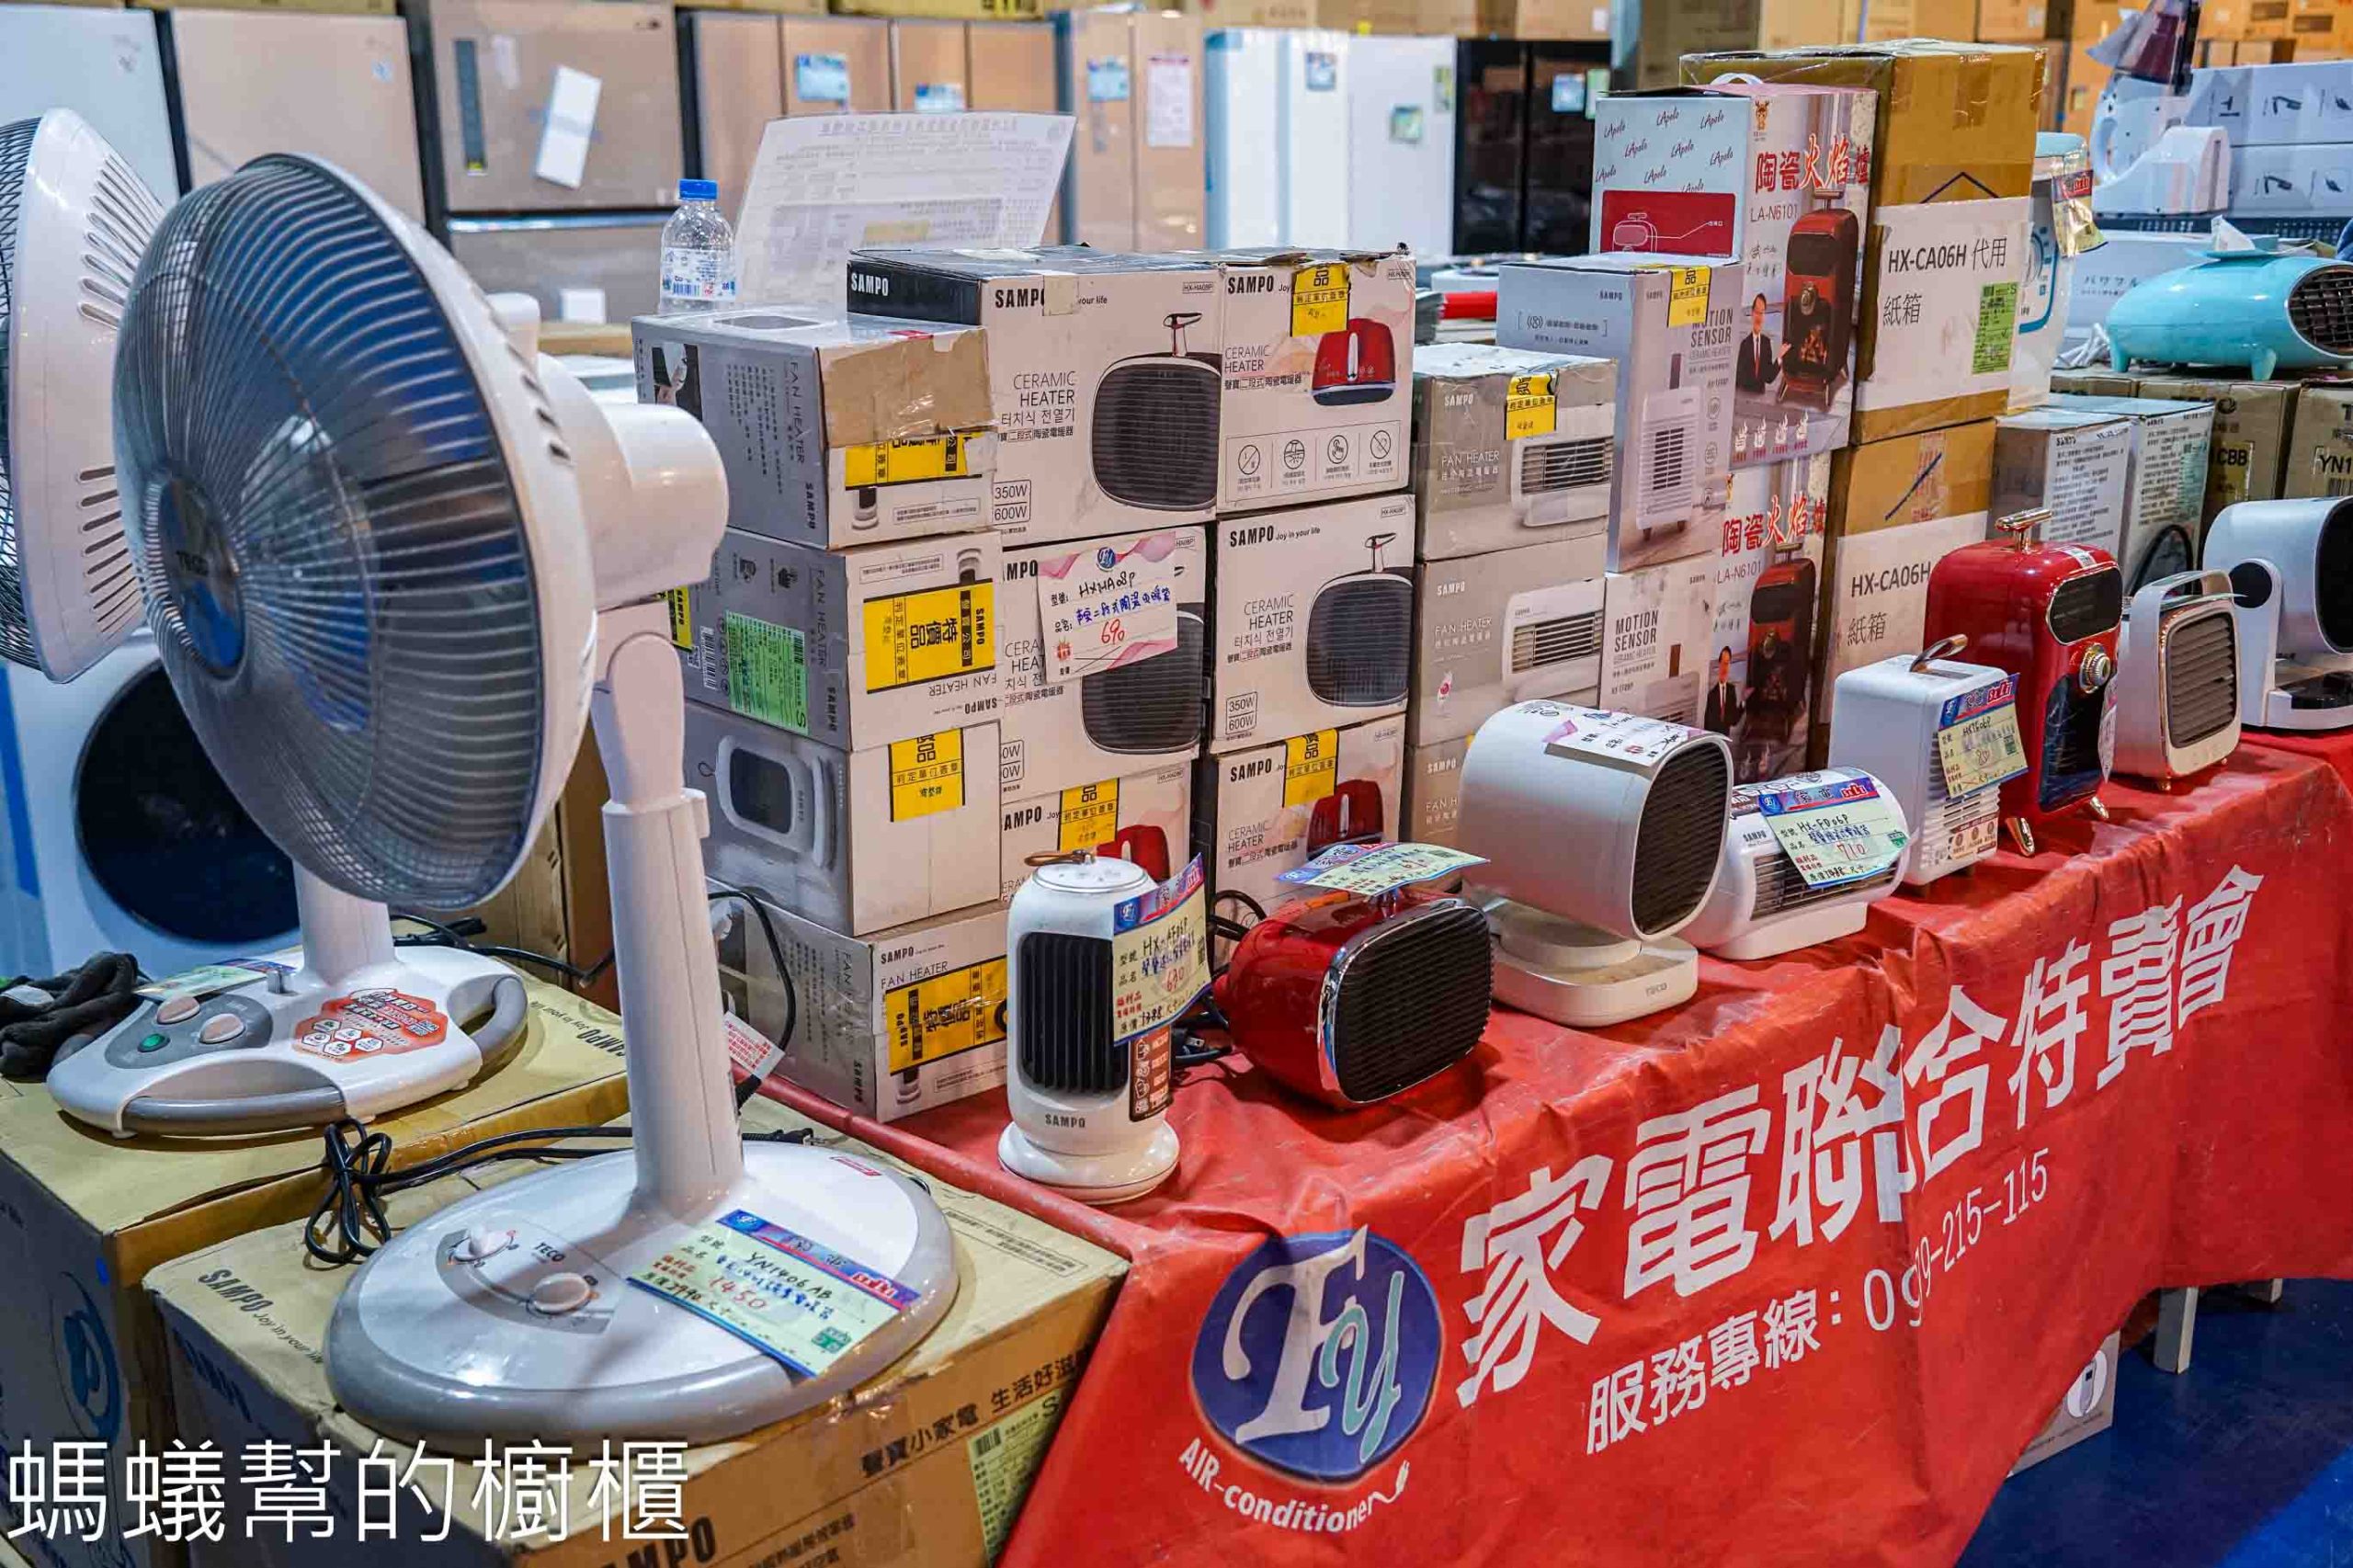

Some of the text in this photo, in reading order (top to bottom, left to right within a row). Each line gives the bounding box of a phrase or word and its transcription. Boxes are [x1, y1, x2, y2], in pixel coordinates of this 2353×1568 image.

[1750, 203, 1799, 222] LA-N6101
[1888, 235, 2007, 274] HX-CA06H 代用
[849, 273, 891, 298] SAMPO
[1227, 275, 1275, 295] SAMPO
[995, 287, 1045, 309] SAMP
[1882, 291, 1923, 327] 紙箱
[1690, 326, 1732, 348] SENSOR
[1224, 345, 1270, 359] CERAMIC
[1224, 359, 1265, 373] HEATER
[1013, 370, 1075, 390] CERAMIC
[1019, 390, 1075, 407] HEATER
[1444, 393, 1473, 407] SAMPO
[1040, 407, 1075, 425] 전열기
[1466, 449, 1500, 463] HEATER
[2320, 455, 2353, 474] YN1
[994, 483, 1029, 499] 350W
[803, 482, 817, 530] SAMPO
[994, 506, 1028, 521] 600W
[1230, 525, 1274, 548] SAMPO
[1276, 531, 1288, 541] Joy
[1295, 529, 1312, 540] your
[1312, 527, 1321, 535] life
[1003, 560, 1038, 581] MPO
[1716, 560, 1762, 585] LA-N6101
[1851, 562, 1931, 598] HX-CA06H
[1437, 581, 1465, 597] SAMPO
[1244, 594, 1294, 616] CERAMIC
[975, 608, 985, 645] SAMPO
[1249, 610, 1293, 631] HEATER
[1434, 623, 1456, 636] FAN
[1616, 609, 1659, 636] MOTION
[1847, 611, 1887, 645] 紙箱
[910, 618, 958, 650] 特價品
[1614, 628, 1657, 653] SENSOR
[928, 673, 997, 697] FAN HEATER
[964, 697, 997, 715] SAMPO
[1228, 696, 1255, 712] 350W
[1228, 715, 1255, 732] 600W
[1230, 758, 1273, 782] SAMPO
[1426, 758, 1457, 774] SAMPO
[1426, 800, 1447, 812] FAN
[1003, 805, 1042, 832] AMPO
[1227, 835, 1264, 853] HEATER
[1742, 829, 1768, 843] SAMPO
[1836, 841, 1869, 861] 710
[880, 946, 915, 965] SAMPO
[880, 960, 949, 990] FAN HEATER
[853, 1059, 864, 1103] SAMPO
[1044, 1113, 1086, 1130] SAMPO
[1455, 864, 2265, 1408] 家電聯合特賣會
[535, 1242, 566, 1262] TECO
[198, 1268, 274, 1312] SAMPO
[708, 1274, 767, 1311] 1450
[254, 1312, 277, 1326] Joy
[271, 1322, 286, 1335] in
[278, 1335, 311, 1352] your
[1177, 1437, 1379, 1534] AIR-conditioner
